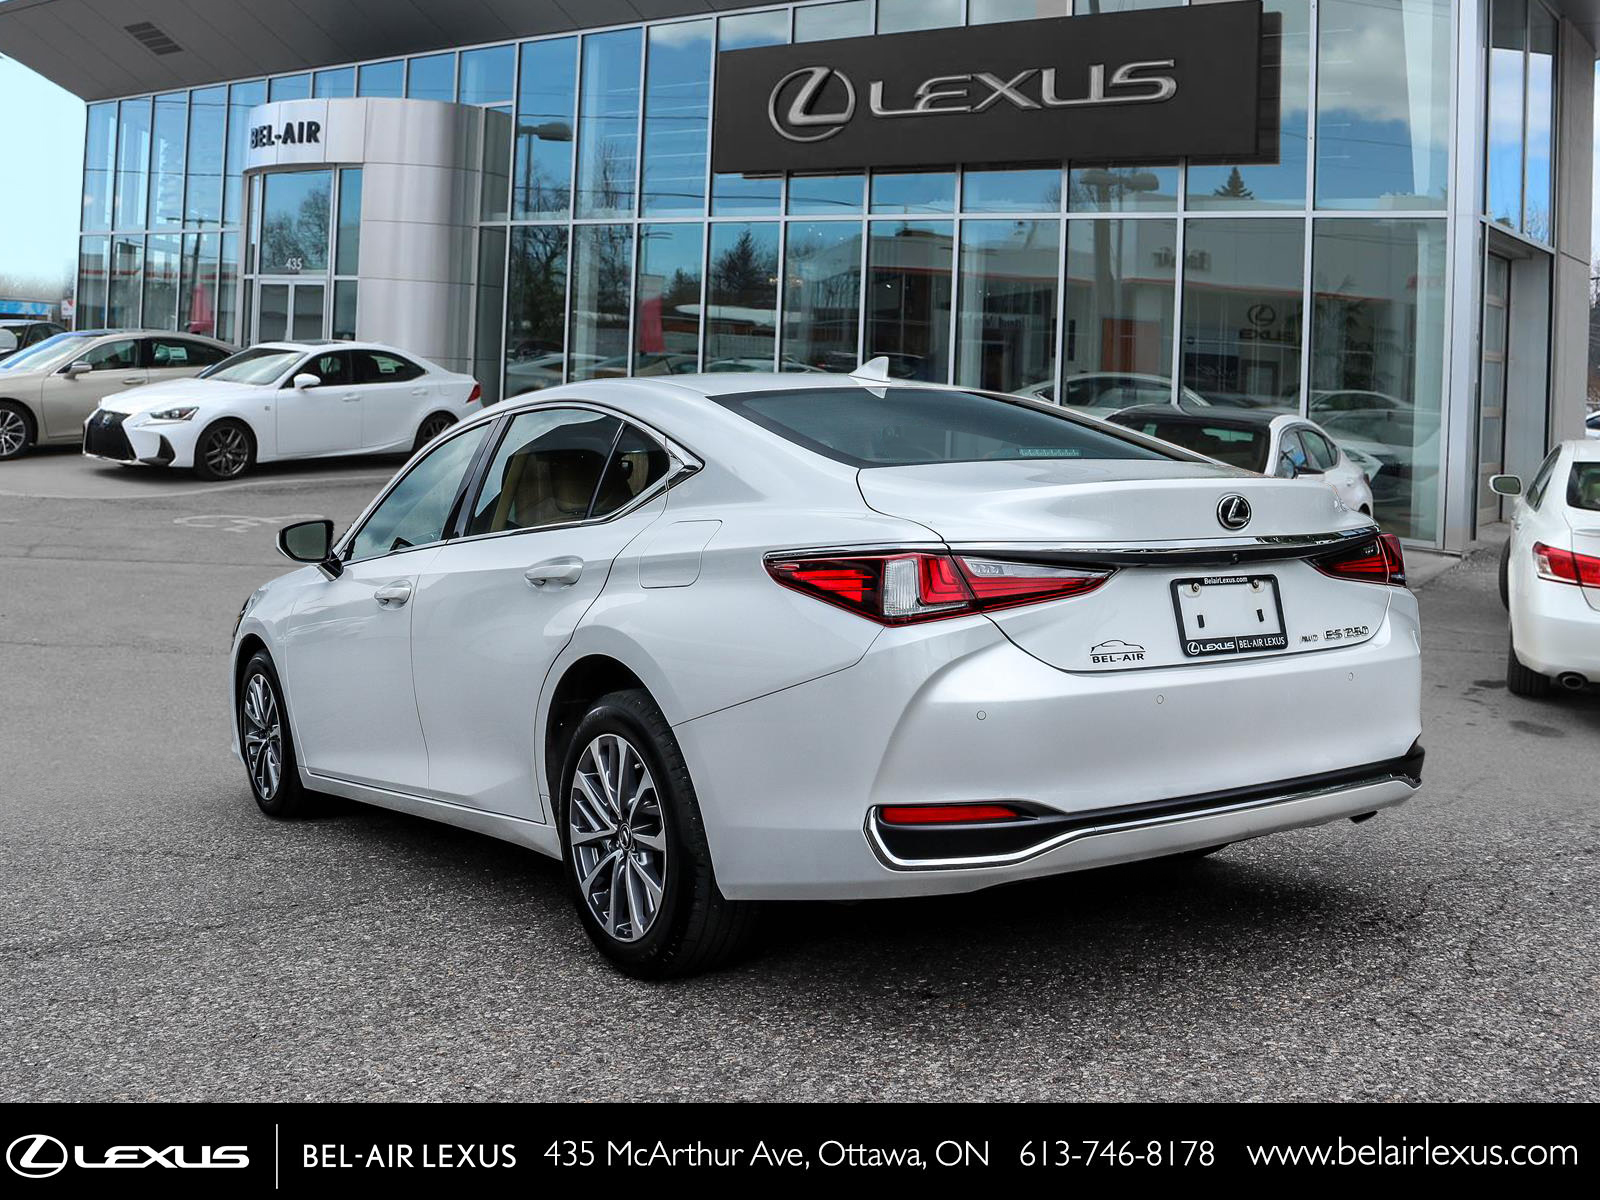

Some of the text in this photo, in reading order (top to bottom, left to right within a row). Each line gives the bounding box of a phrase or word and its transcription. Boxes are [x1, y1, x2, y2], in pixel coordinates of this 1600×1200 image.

[869, 59, 1178, 118] LEXUS
[250, 121, 321, 149] BEL-AIR
[285, 257, 303, 271] 435
[1204, 576, 1249, 585] BelairLexus.com
[1323, 628, 1343, 641] ES
[1200, 635, 1286, 652] LEXUS BEL-AIR LEXUS
[1092, 653, 1145, 664] BEL-AIR
